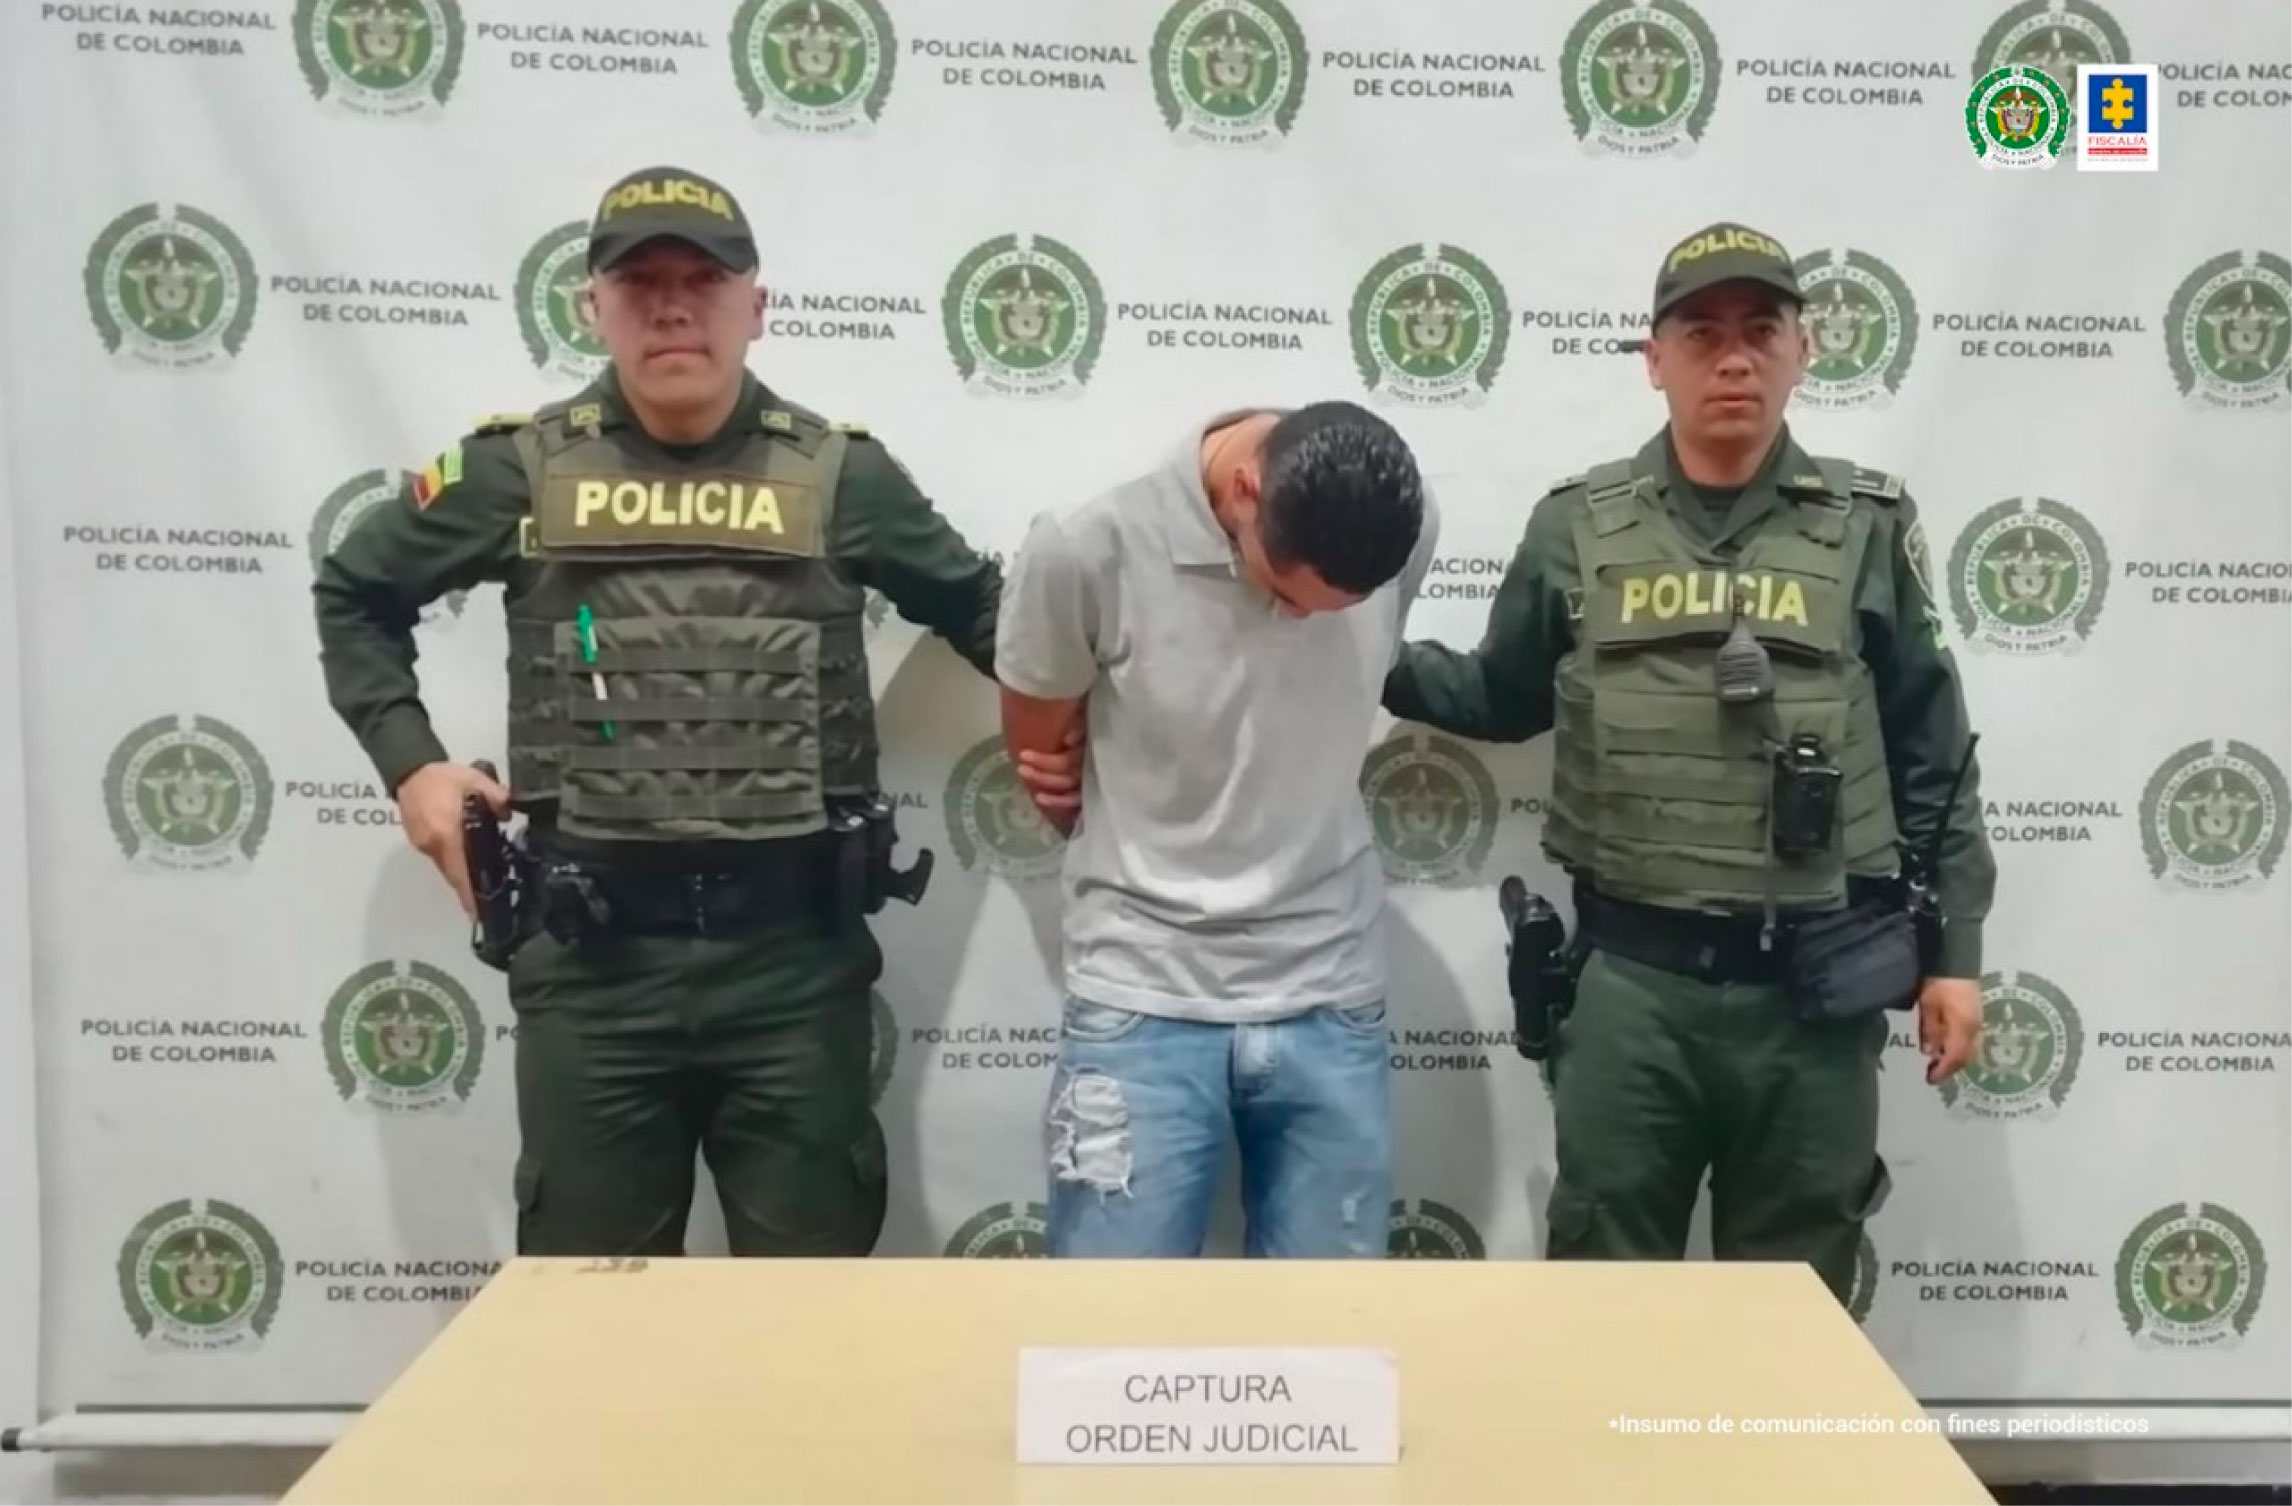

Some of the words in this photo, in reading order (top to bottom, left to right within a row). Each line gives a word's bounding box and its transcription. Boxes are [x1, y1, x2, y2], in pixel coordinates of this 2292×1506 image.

[42, 3, 137, 24] POLICÍA
[147, 8, 276, 30] NACIONAL
[77, 32, 105, 50] DE
[118, 35, 244, 56] COLOMBIA
[478, 22, 571, 44] POLICÍA
[580, 27, 708, 48] NACIONAL
[912, 39, 1005, 58] POLICÍA
[1013, 43, 1137, 64] NACIONAL
[511, 52, 541, 69] DE
[550, 54, 677, 74] COLOMBIA
[1323, 52, 1415, 68] POLICÍA
[1423, 54, 1545, 72] NACIONAL
[1737, 59, 1827, 77] POLICÍA
[1835, 61, 1955, 79] NACIONAL
[2159, 60, 2240, 80] OLICÍA
[943, 68, 972, 85] DE
[981, 69, 1105, 90] COLOMBIA
[1354, 79, 1382, 96] DE
[1391, 79, 1513, 97] COLOMBIA
[1767, 86, 1794, 103] DE
[1803, 88, 1923, 105] COLOMBIA
[2177, 91, 2205, 107] DE
[603, 179, 734, 222] POLICIA
[271, 276, 362, 295] POLICÍA
[370, 279, 500, 301] NACIONAL
[801, 294, 927, 315] NACIONAL
[1118, 302, 1208, 320] POLICÍA
[1215, 305, 1332, 324] NACIONAL
[304, 304, 335, 322] DE
[343, 305, 468, 326] COLOMBIA
[1523, 311, 1613, 328] POLICÍA
[1933, 312, 2019, 331] POLICÍA
[2026, 315, 2145, 332] NACIONAL
[769, 319, 896, 340] COLOMBIA
[1147, 330, 1176, 347] DE
[1183, 331, 1302, 349] COLOMBIA
[1552, 338, 1581, 354] DE
[1962, 340, 1987, 356] DE
[1994, 341, 2113, 358] COLOMBIA
[575, 481, 784, 534] POLICIA
[64, 526, 159, 544] POLICÍA
[168, 530, 292, 548] NACIONAL
[97, 553, 126, 571] DE
[135, 555, 263, 573] COLOMBIA
[1431, 558, 1503, 575] ACION
[2125, 562, 2212, 578] POLICÍA
[2219, 562, 2292, 578] NACIO
[2152, 587, 2179, 603] DE
[285, 781, 377, 799] POLICÍA
[317, 808, 346, 824] DE
[2007, 802, 2122, 817] NACIONAL
[1986, 826, 2091, 842] OLOMBIA
[82, 1019, 174, 1036] POLICÍA
[181, 1021, 306, 1038] NACIONAL
[912, 1021, 1002, 1044] POLICÍA
[2098, 1033, 2184, 1047] POLICÍA
[2192, 1033, 2292, 1047] NACIONA
[113, 1046, 142, 1062] DE
[150, 1046, 276, 1062] COLOMBIA
[942, 1053, 971, 1069] DE
[978, 1052, 1058, 1069] COLOM
[1390, 1054, 1491, 1071] OLOMBIA
[2126, 1056, 2152, 1071] DE
[2161, 1056, 2274, 1071] COLOMBIA
[296, 1261, 387, 1277] POLICÍA
[395, 1260, 501, 1277] NACIONA
[1892, 1262, 1976, 1277] POLICÍA
[1982, 1261, 2096, 1277] NACIONAL
[327, 1286, 355, 1301] DE
[1920, 1286, 1946, 1300] DE
[1953, 1284, 2067, 1300] COLOMBIA
[1125, 1374, 1291, 1402] CAPTURA
[1067, 1424, 1191, 1453] ORDEN
[1203, 1424, 1357, 1453] JUDICIAL
